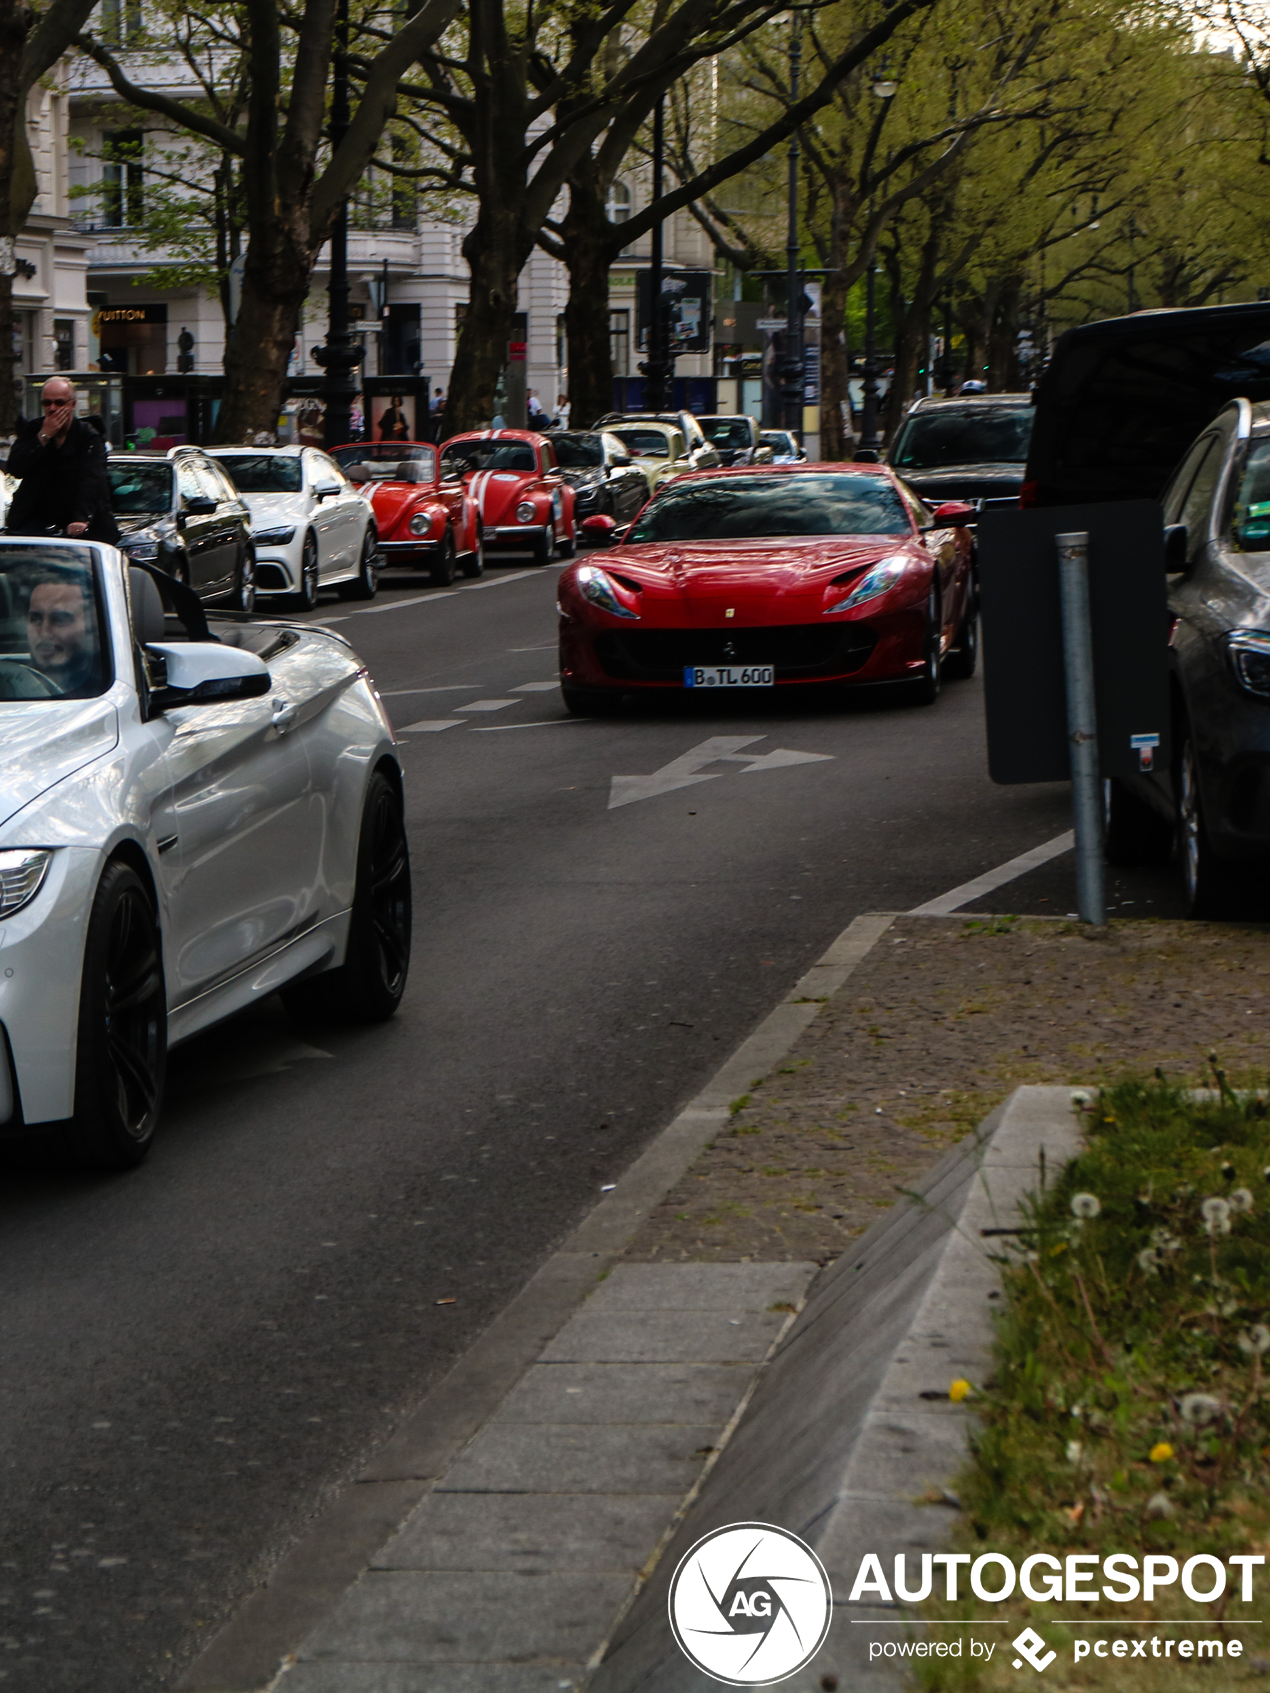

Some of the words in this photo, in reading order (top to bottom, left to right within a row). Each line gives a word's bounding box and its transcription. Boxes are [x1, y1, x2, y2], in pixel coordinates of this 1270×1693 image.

[694, 669, 705, 685] B
[716, 668, 738, 684] TL
[741, 668, 772, 684] 600
